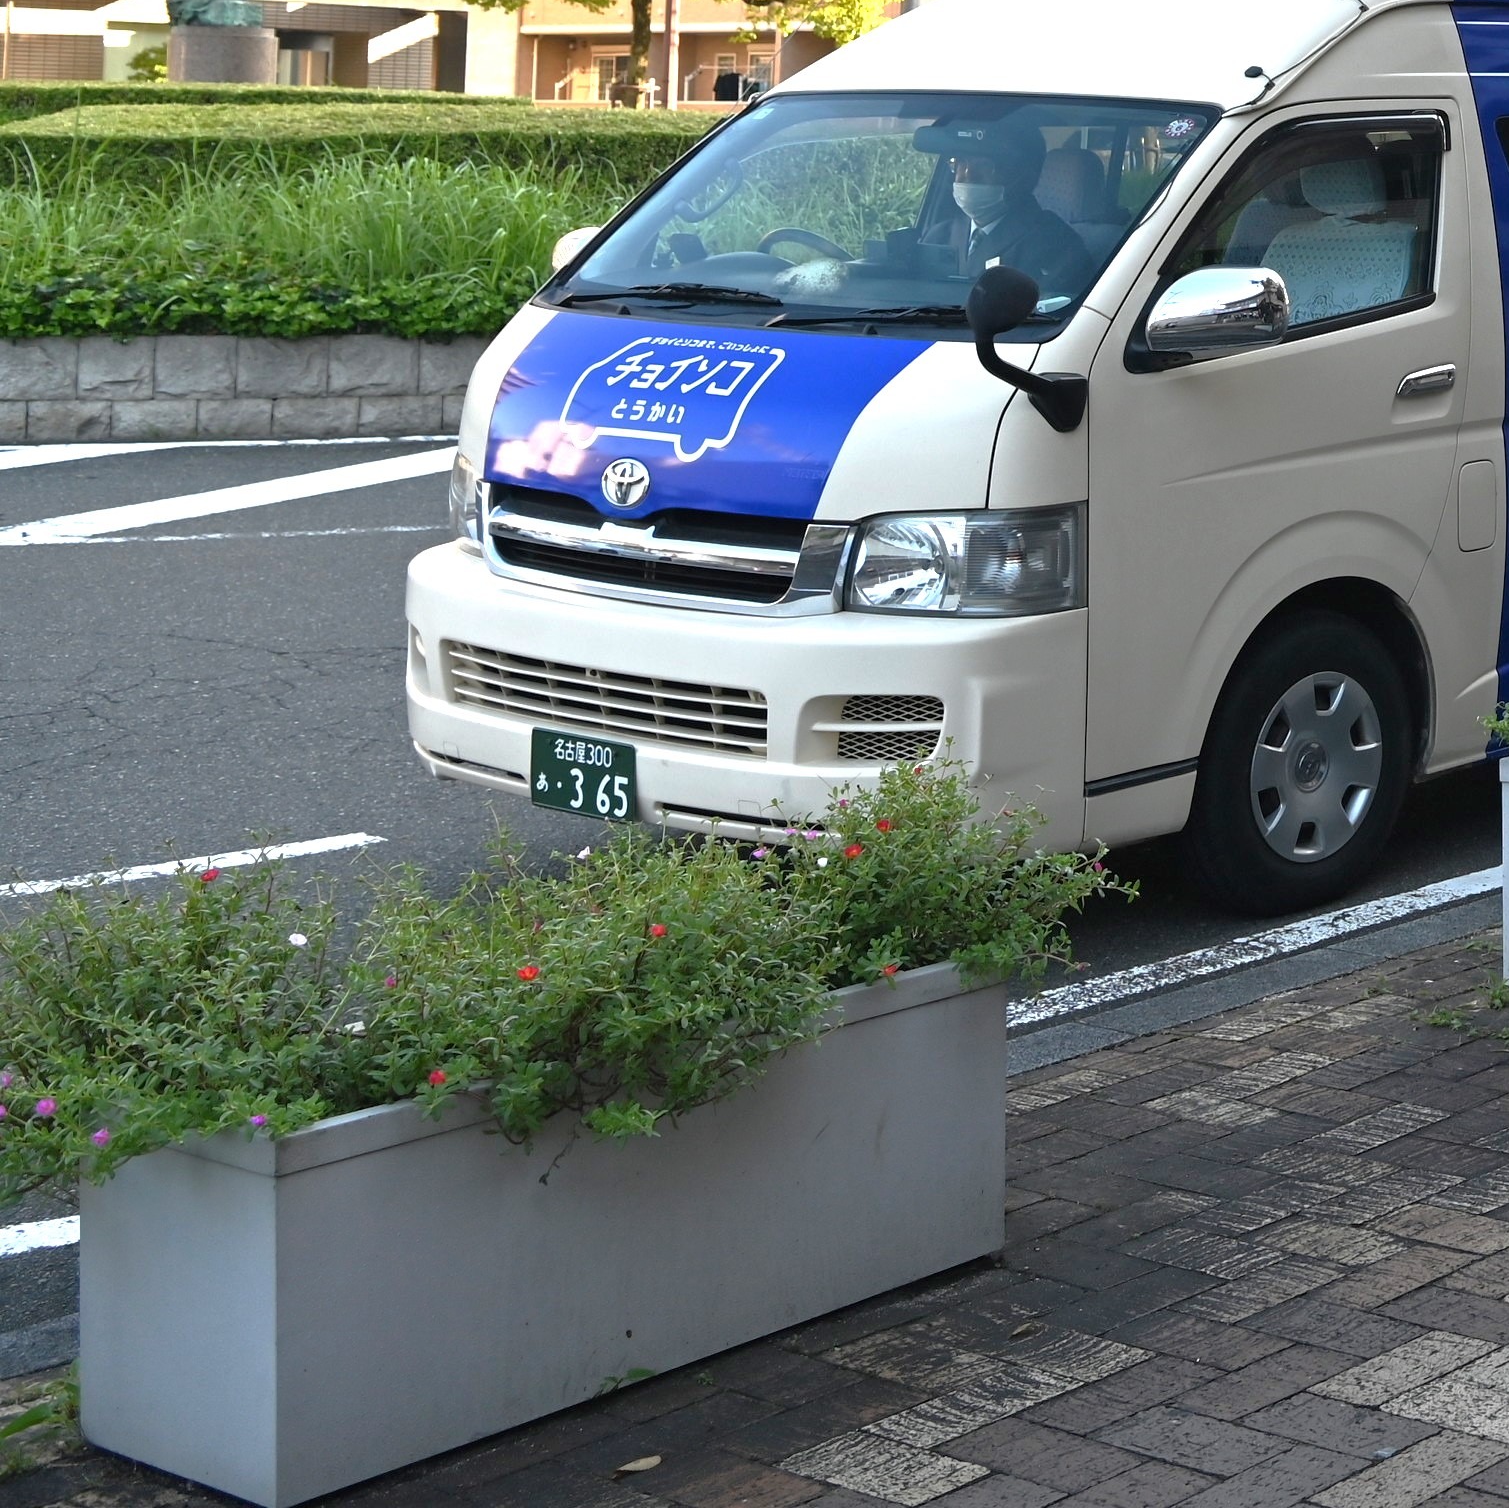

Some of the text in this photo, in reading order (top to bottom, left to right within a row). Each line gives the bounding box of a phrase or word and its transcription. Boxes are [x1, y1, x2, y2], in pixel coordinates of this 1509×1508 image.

[606, 350, 755, 397] チョイソコ
[610, 398, 686, 424] とうかい
[553, 738, 612, 768] 名古屋300
